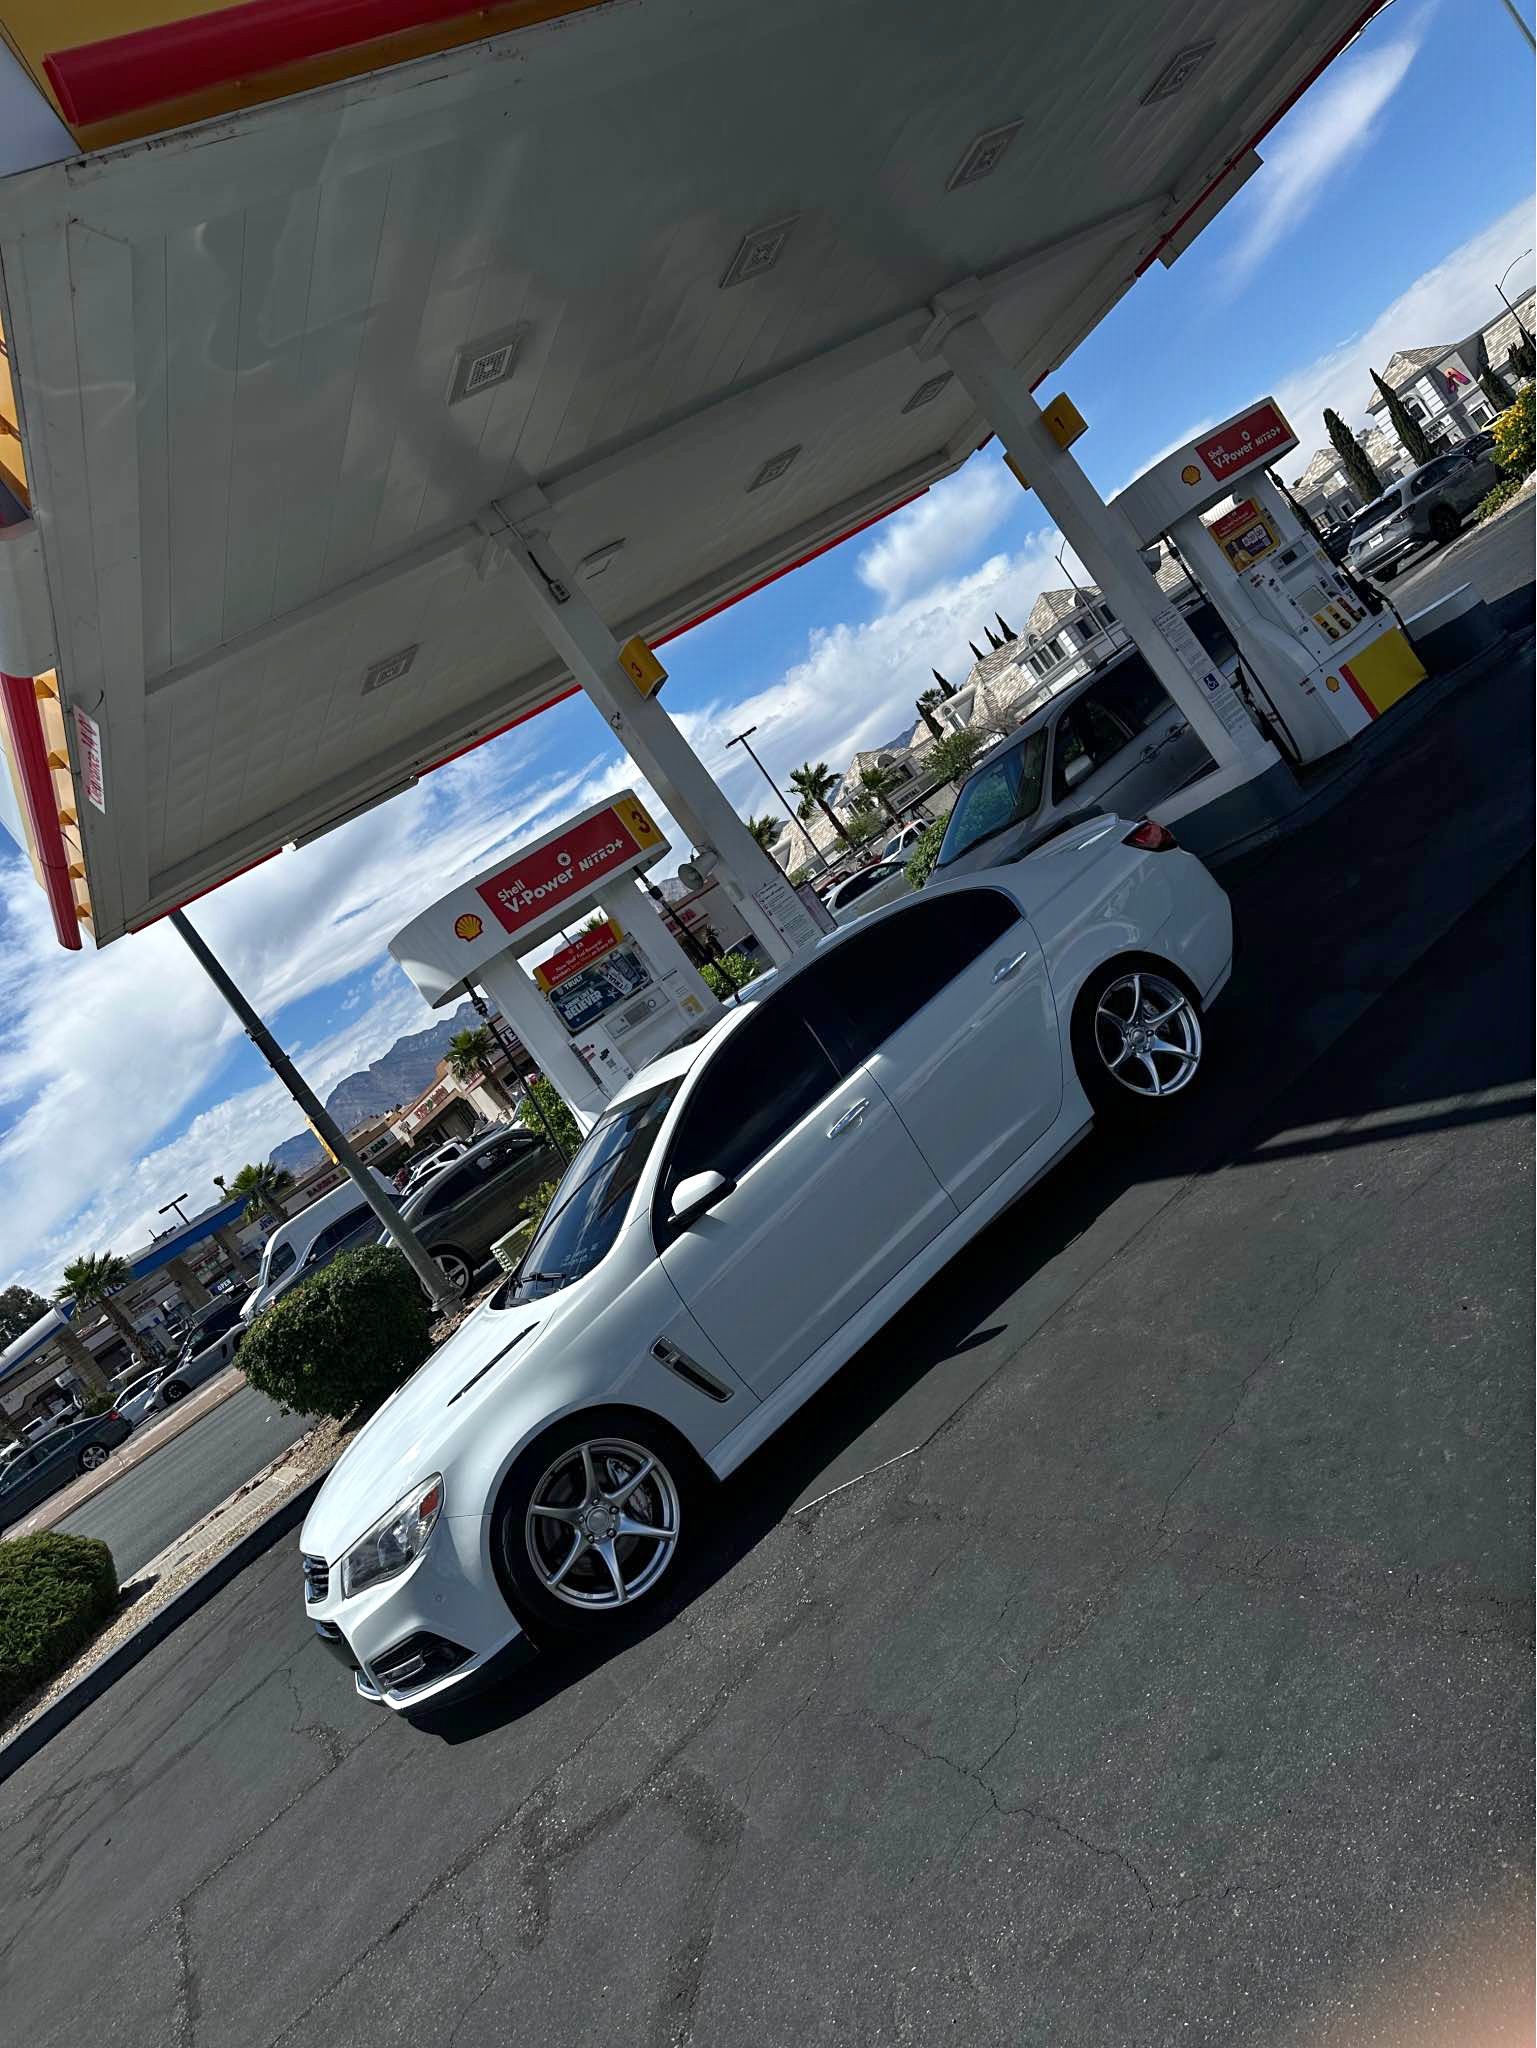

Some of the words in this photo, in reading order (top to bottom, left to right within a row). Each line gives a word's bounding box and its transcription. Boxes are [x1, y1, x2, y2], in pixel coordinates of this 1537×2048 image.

[1213, 441, 1253, 468] V-Power
[631, 662, 642, 678] 3
[631, 810, 650, 834] 3
[497, 878, 525, 902] Shell
[504, 865, 575, 914] V-Power
[564, 975, 583, 989] TRULY
[563, 989, 603, 1020] BELIEVER
